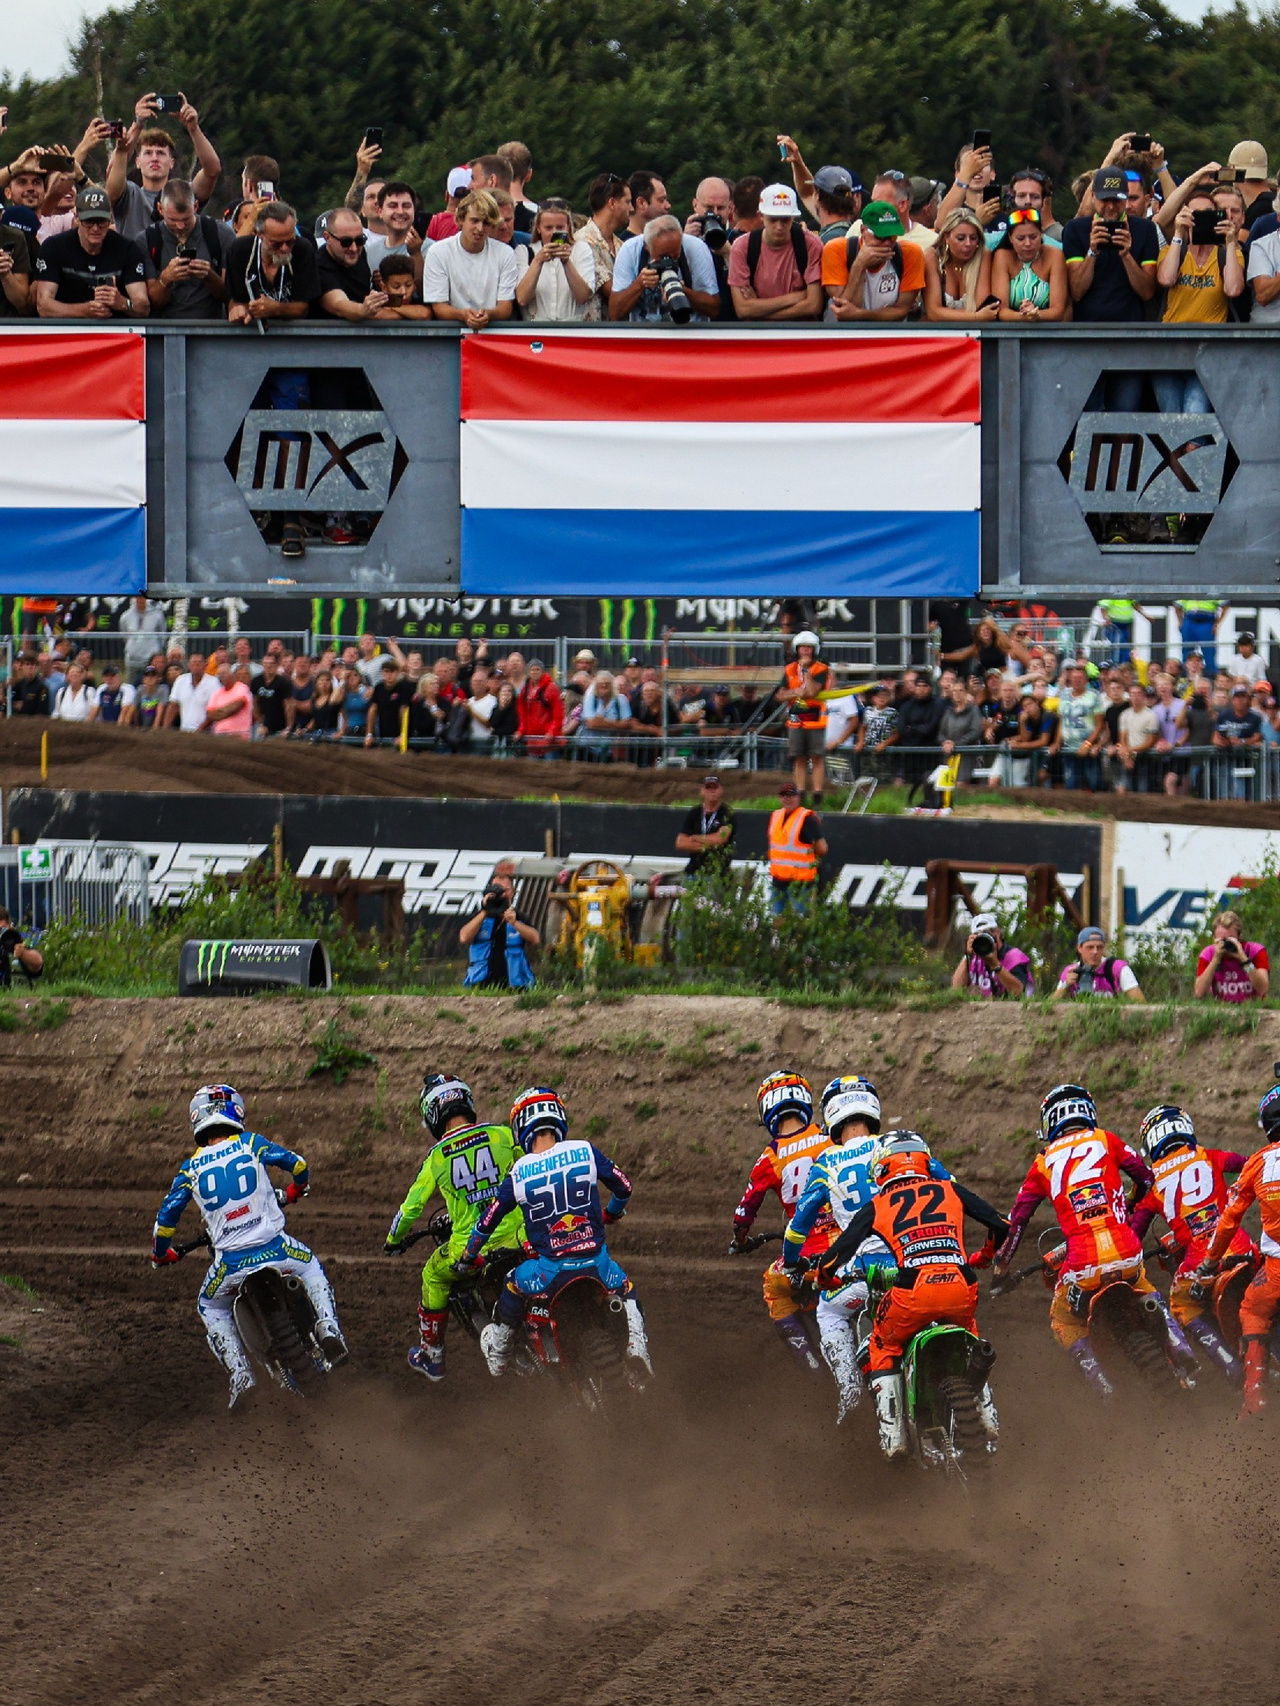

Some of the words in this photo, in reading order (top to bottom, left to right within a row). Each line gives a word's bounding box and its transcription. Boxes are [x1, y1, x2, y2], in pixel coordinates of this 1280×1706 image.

[84, 193, 105, 203] FOX
[403, 621, 531, 637] ENERGY
[230, 944, 301, 957] MONSTER
[451, 1145, 499, 1193] 44
[1045, 1141, 1109, 1200] 72
[199, 1154, 258, 1211] 96
[524, 1164, 592, 1222] 516
[1156, 1160, 1214, 1223] 79
[466, 1186, 501, 1205] YAMAHA
[889, 1183, 948, 1236] 22
[1081, 1207, 1108, 1221] KTM
[550, 1232, 573, 1249] Red
[573, 1226, 593, 1243] Bull
[904, 1254, 965, 1269] Kawasaki
